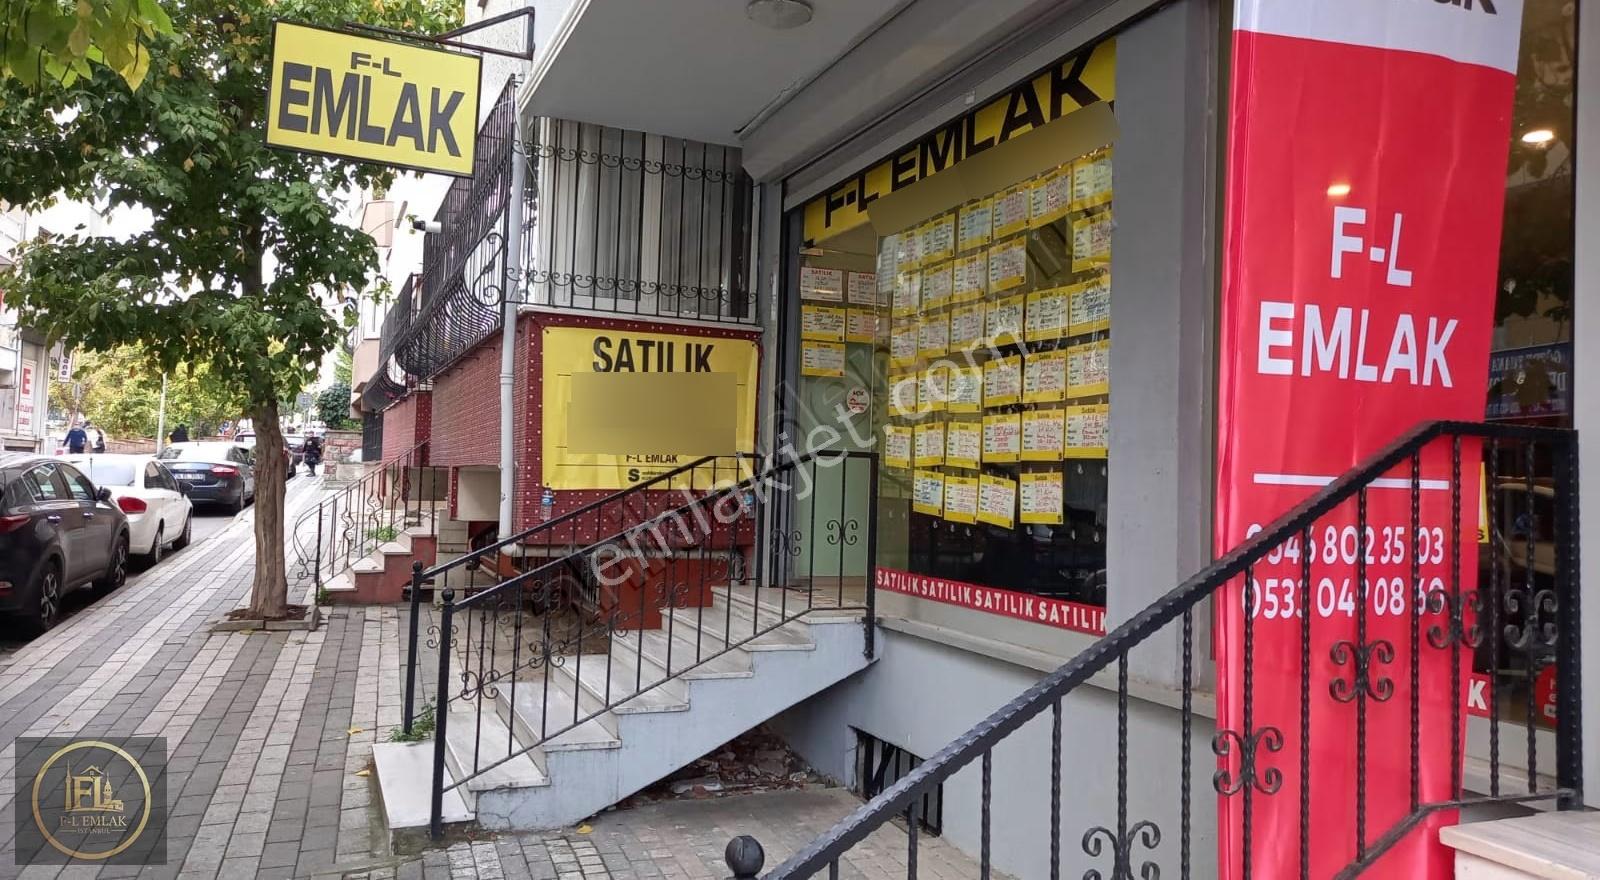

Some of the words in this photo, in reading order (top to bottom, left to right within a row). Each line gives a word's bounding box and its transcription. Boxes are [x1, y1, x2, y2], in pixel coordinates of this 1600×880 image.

[350, 51, 403, 78] F-L
[278, 62, 466, 157] EMLAK
[825, 174, 880, 228] F-L
[891, 49, 1101, 192] EMLAK
[1330, 206, 1413, 287] F-L
[592, 335, 715, 373] SATILIK
[1257, 301, 1459, 388] EMLAK
[645, 454, 678, 464] EMLAK
[1322, 525, 1375, 565] 802
[1380, 526, 1405, 565] 35
[1418, 526, 1444, 565] 03
[877, 570, 919, 595] SATILIK
[921, 578, 971, 605] SATILIK
[974, 589, 1034, 617] SATILIK
[1374, 577, 1405, 616] 08
